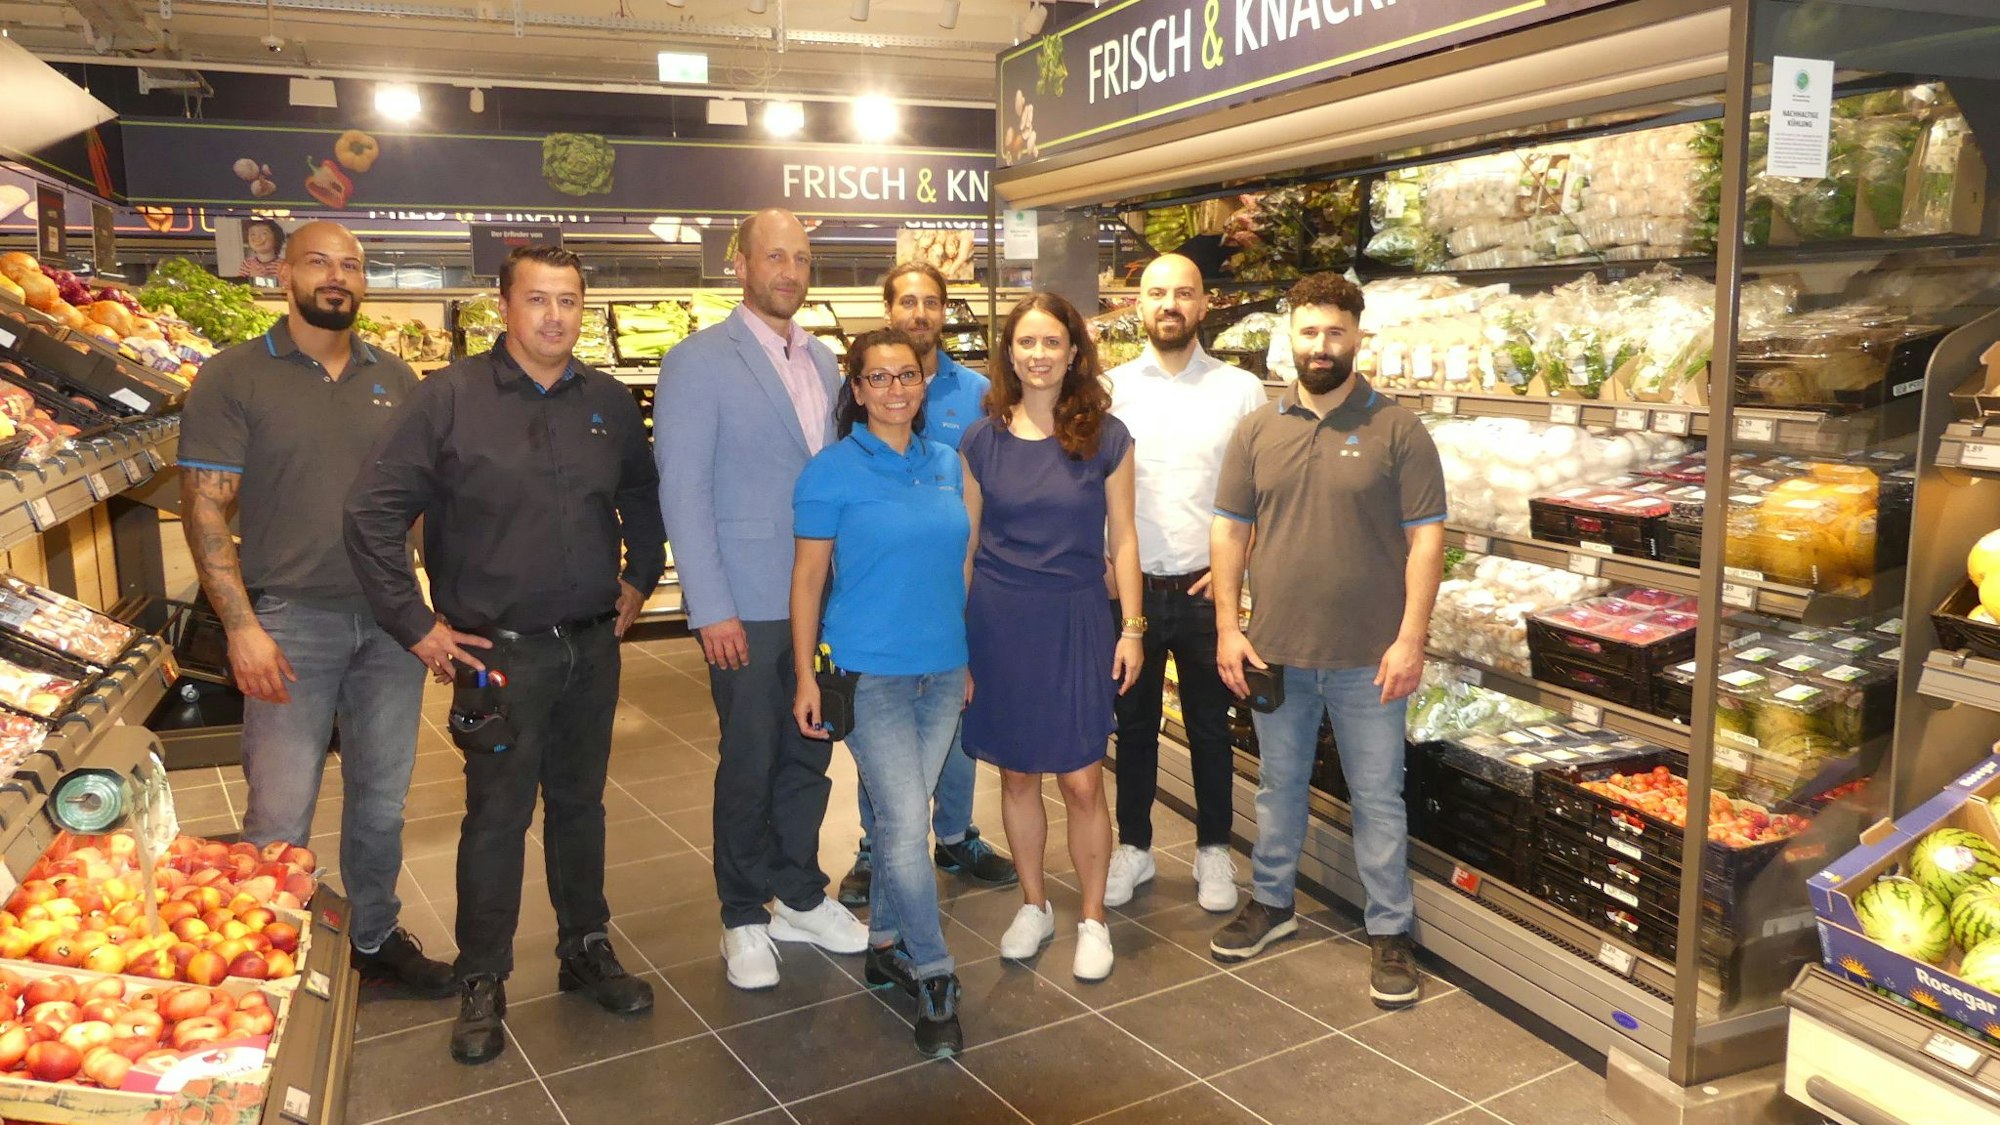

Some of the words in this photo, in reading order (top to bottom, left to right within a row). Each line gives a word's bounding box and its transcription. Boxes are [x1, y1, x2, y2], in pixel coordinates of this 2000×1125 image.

[1089, 8, 1191, 104] FRISCH
[1201, 0, 1224, 70] &
[783, 165, 906, 200] FRISCH
[916, 168, 937, 203] &
[1914, 967, 1998, 1016] Rosegar
